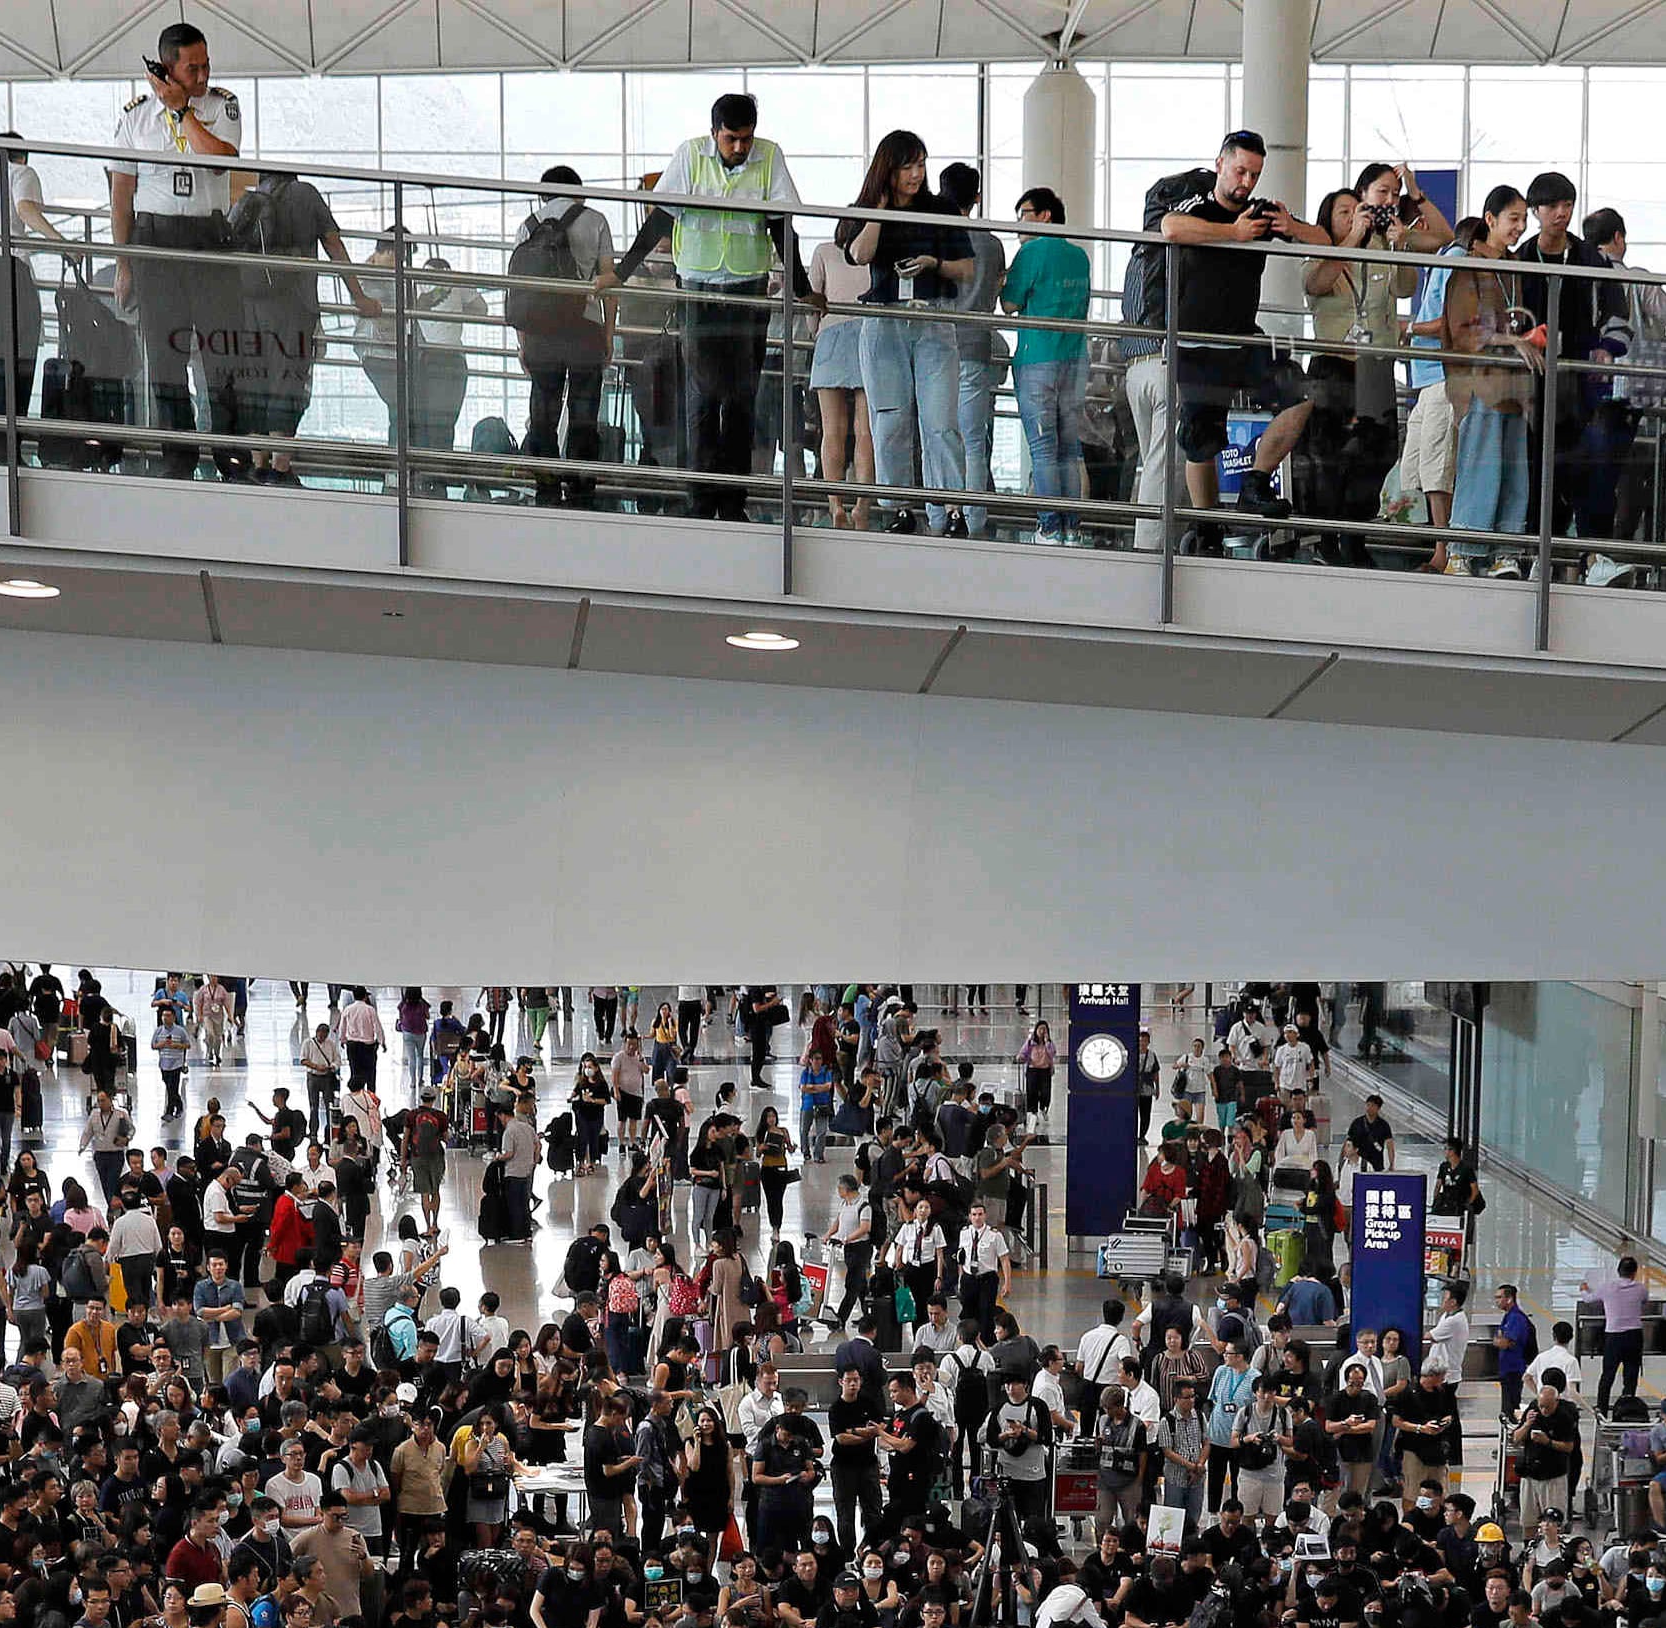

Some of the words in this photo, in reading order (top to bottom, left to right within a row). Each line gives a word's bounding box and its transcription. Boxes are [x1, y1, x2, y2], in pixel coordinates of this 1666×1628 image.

[1221, 448, 1238, 459] TOTO
[1079, 997, 1110, 1006] Arrivals
[1113, 996, 1129, 1005] Hall
[1365, 1219, 1397, 1231] Group
[1365, 1229, 1401, 1240] Pick-up
[1364, 1240, 1388, 1250] Area
